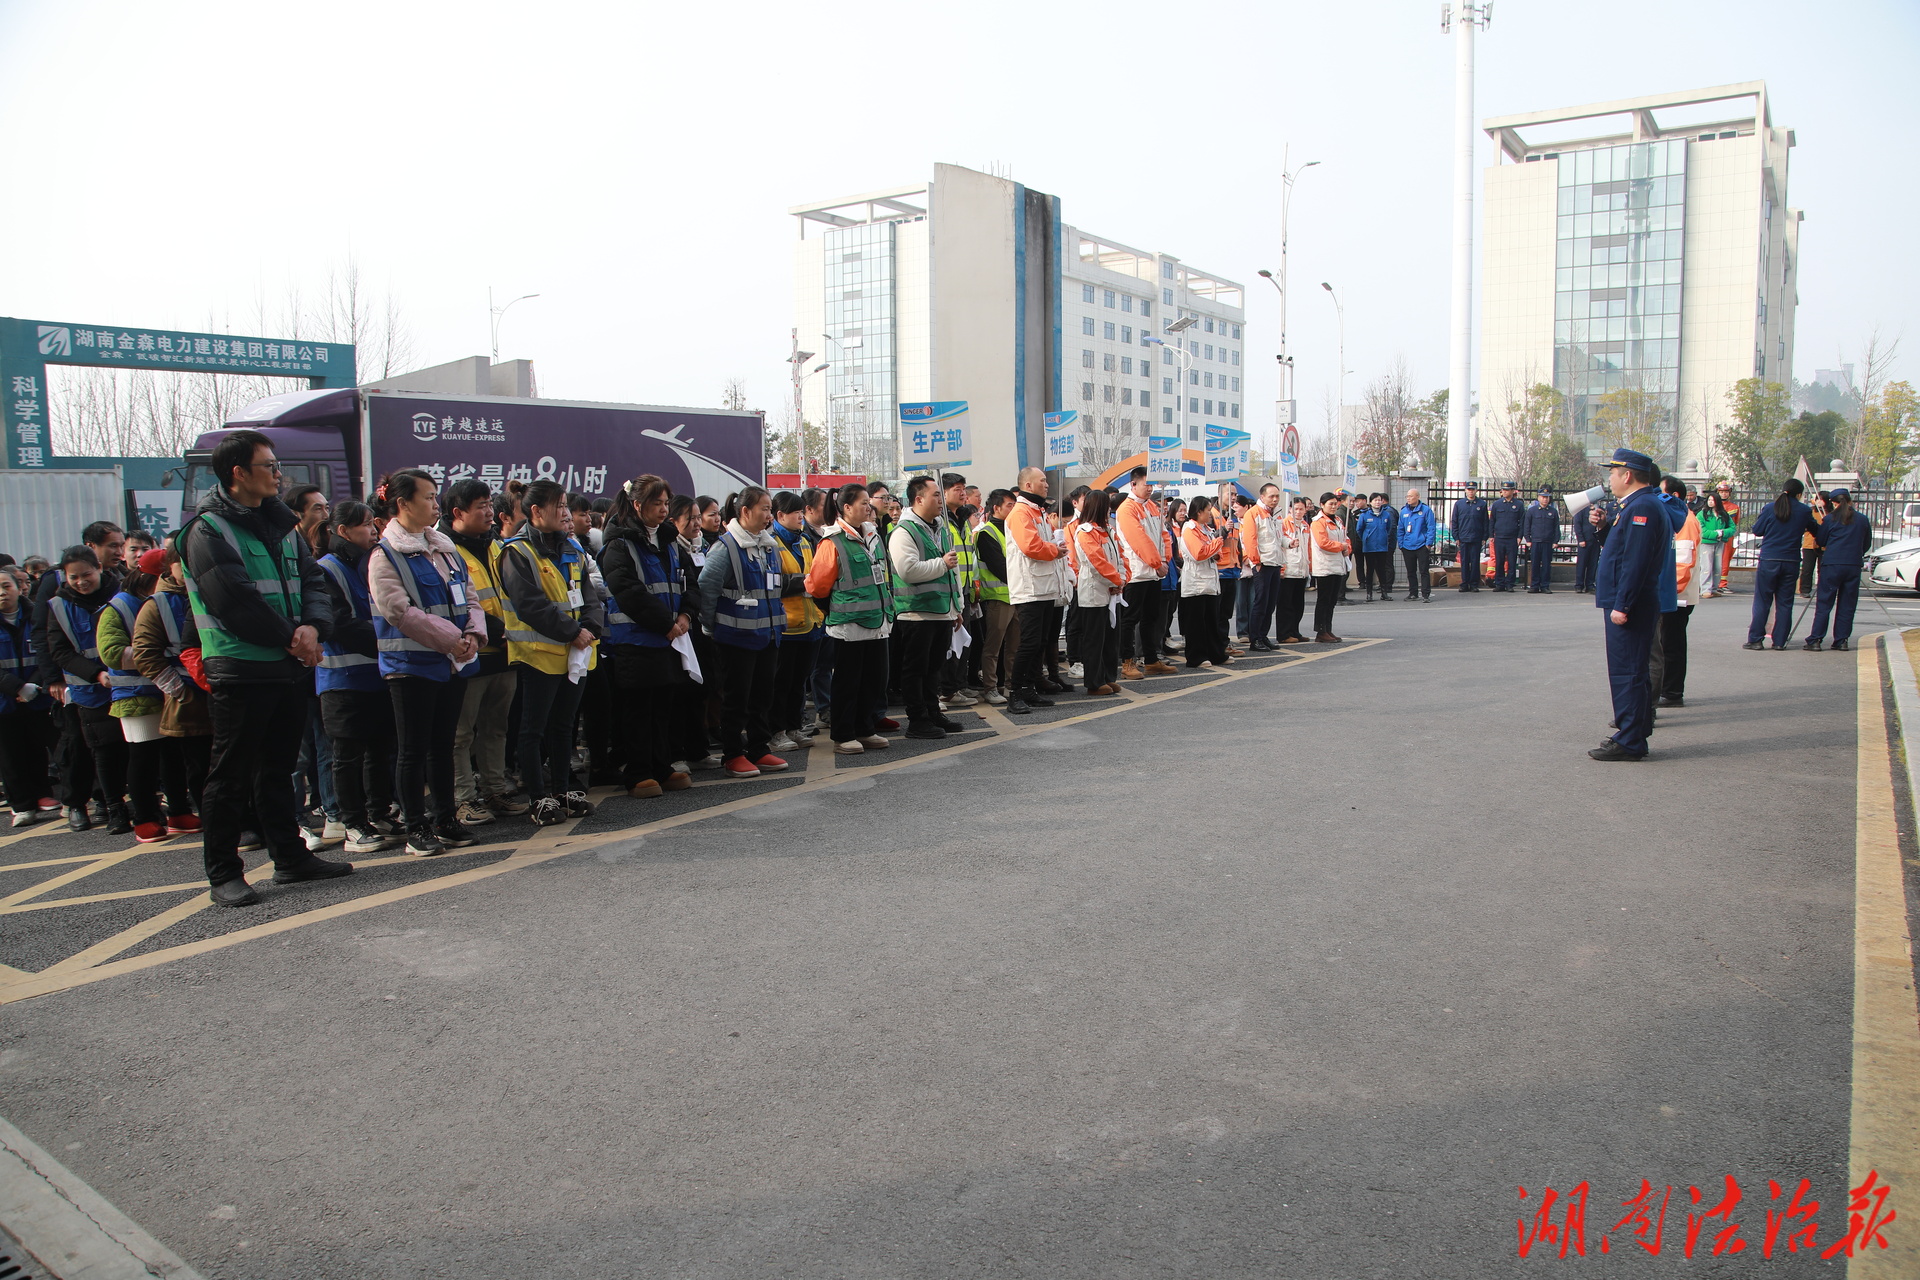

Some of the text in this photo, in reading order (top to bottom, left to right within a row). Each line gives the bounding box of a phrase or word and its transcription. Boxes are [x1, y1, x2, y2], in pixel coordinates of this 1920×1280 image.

[75, 328, 329, 363] 湖南金森电力建设集团有限公司
[12, 376, 44, 466] 科学管理
[413, 420, 437, 433] KYE
[441, 415, 505, 433] 跨越速运
[442, 433, 505, 441] KUAYUE-EXPRESS
[912, 429, 963, 454] 生产部
[1050, 435, 1075, 456] 物控部
[1150, 458, 1180, 473] 技术开发部
[1211, 456, 1235, 473] 质量部
